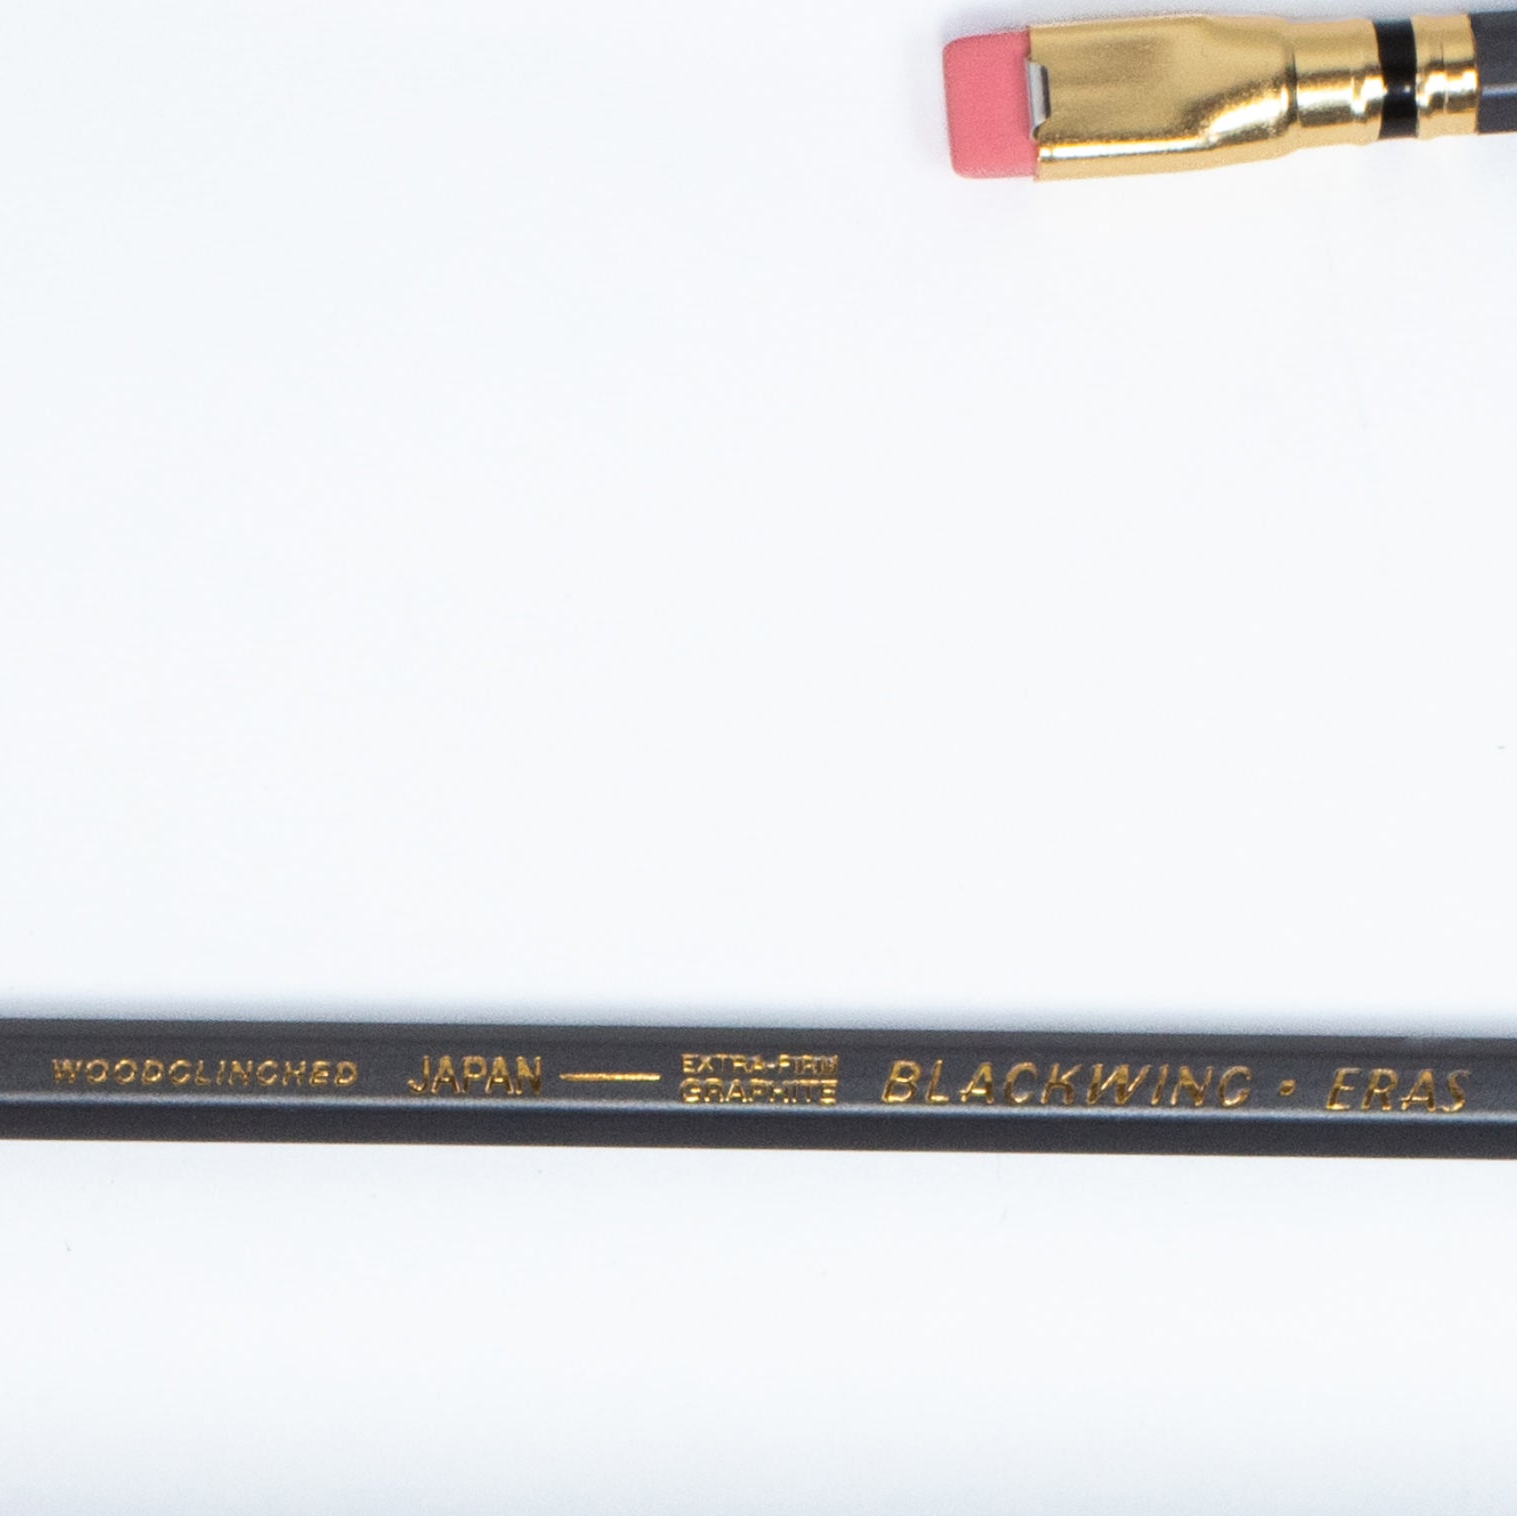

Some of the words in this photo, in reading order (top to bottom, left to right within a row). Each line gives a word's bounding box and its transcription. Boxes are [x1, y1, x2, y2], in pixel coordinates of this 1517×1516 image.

[51, 1058, 360, 1086] WOODCLINCHED
[407, 1055, 543, 1095] JAPAN
[681, 1053, 839, 1074] EXTRA-FIRM
[680, 1077, 839, 1104] GRAPHITE
[882, 1058, 1252, 1107] BLACKWING
[1325, 1067, 1472, 1112] ERAS
